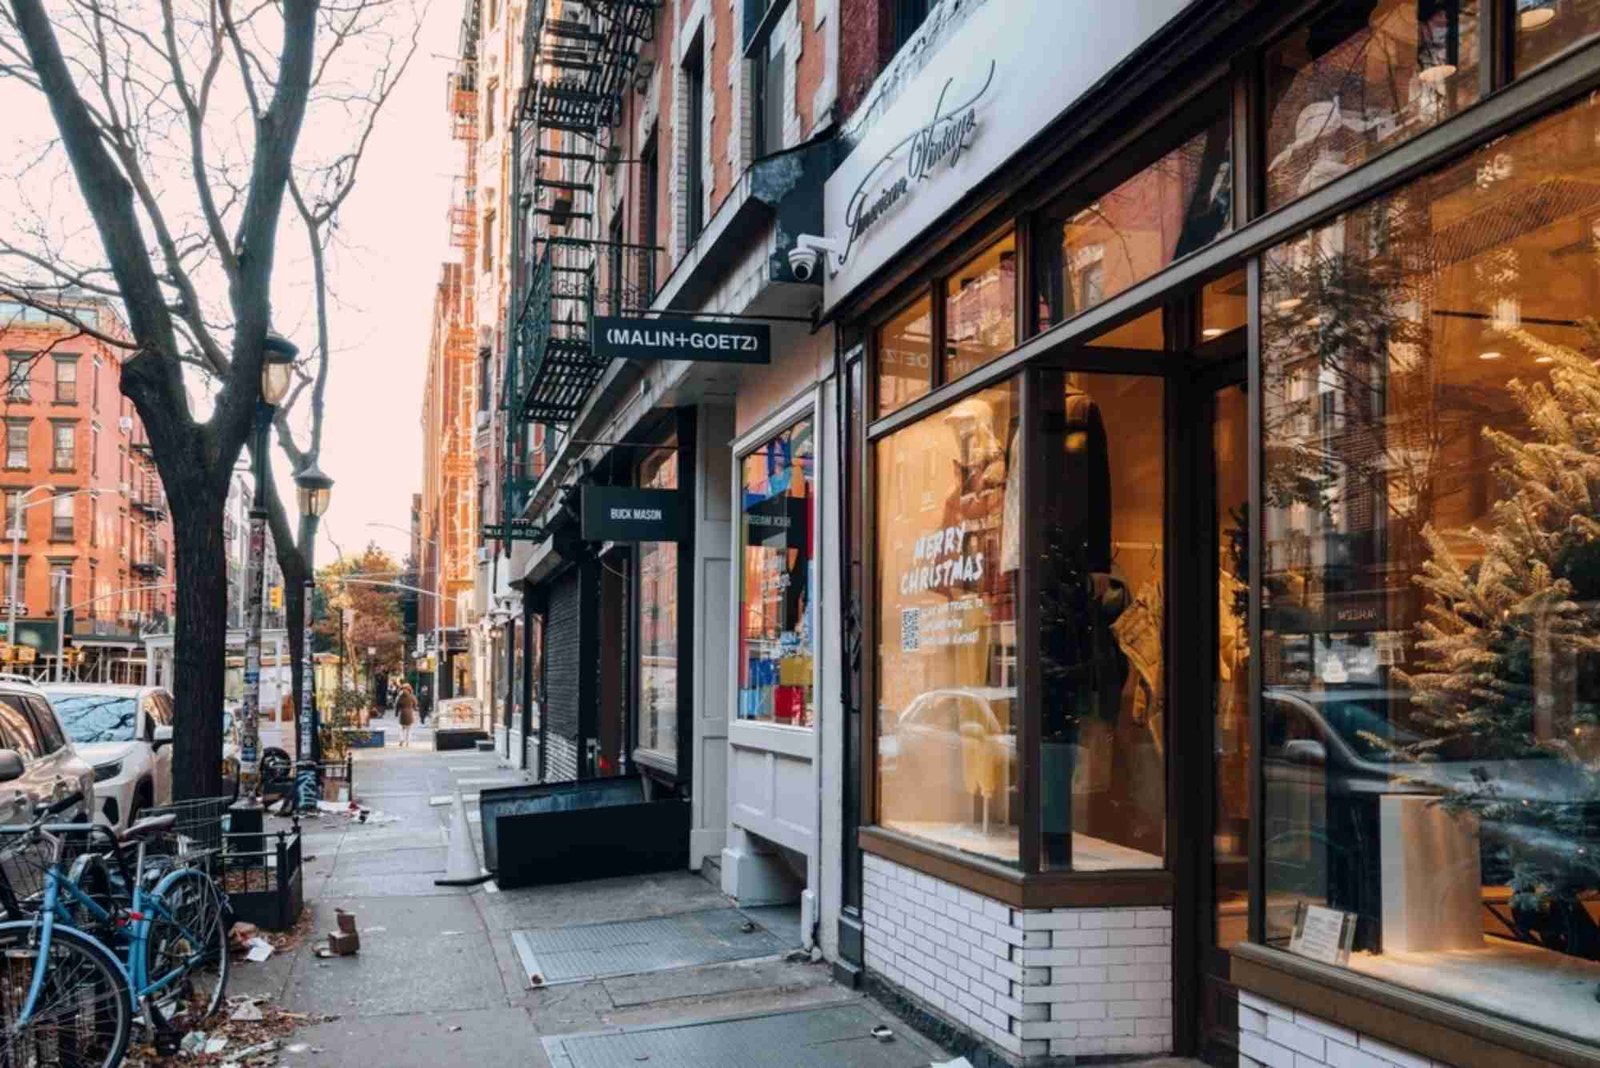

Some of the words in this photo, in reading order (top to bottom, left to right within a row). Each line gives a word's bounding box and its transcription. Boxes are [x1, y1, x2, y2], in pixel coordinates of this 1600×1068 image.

[606, 328, 758, 351] (MALIN+GOETZ)
[610, 507, 632, 520] BUCK
[633, 508, 662, 520] MASON
[914, 521, 966, 558] MERRY
[901, 551, 983, 595] CHRISTMAS
